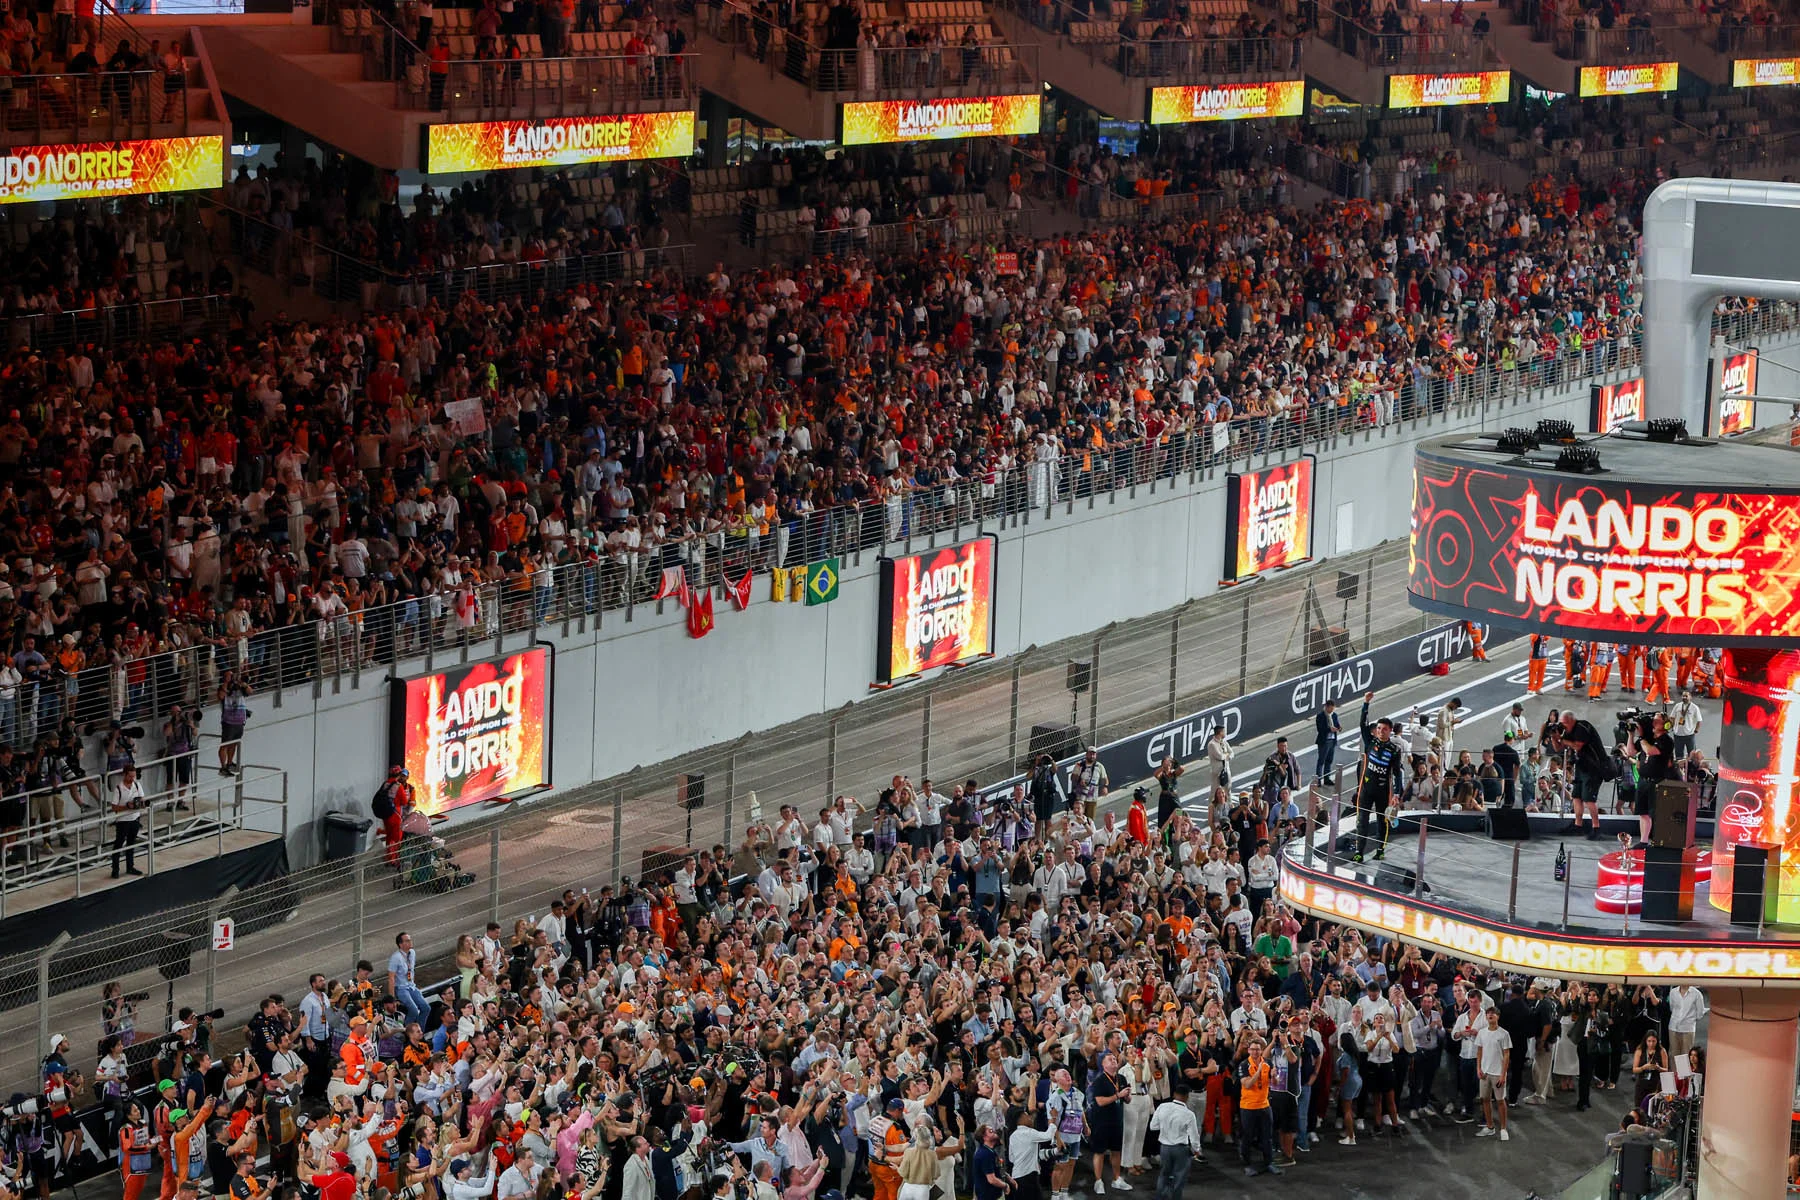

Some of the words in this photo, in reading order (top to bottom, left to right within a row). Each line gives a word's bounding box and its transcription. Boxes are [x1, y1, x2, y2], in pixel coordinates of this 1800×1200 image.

[1194, 90, 1229, 109] LANDO
[1230, 88, 1267, 107] NORRIS
[1424, 78, 1450, 96] LANDO
[1452, 76, 1481, 94] NORRIS
[898, 105, 944, 127] LANDO
[946, 103, 993, 125] NORRIS
[504, 125, 566, 153] LANDO
[568, 121, 632, 148] NORRIS
[45, 149, 133, 182] NORRIS
[503, 151, 543, 163] WORLD
[604, 146, 630, 156] 2025
[97, 178, 133, 190] 2025
[1249, 478, 1298, 513] LANDO
[1523, 493, 1741, 554] LANDO
[1520, 542, 1578, 560] WORLD
[1583, 551, 1690, 569] CHAMPION
[1694, 557, 1745, 570] 2025
[908, 560, 975, 601] LANDO
[1515, 557, 1747, 619] NORRIS
[1291, 658, 1374, 714] ETIHAD
[428, 677, 523, 731] LANDO
[1146, 707, 1242, 769] ETIHAD
[1313, 885, 1406, 929] 2025
[1415, 912, 1498, 957] LANDO
[1502, 937, 1629, 974] NORRIS
